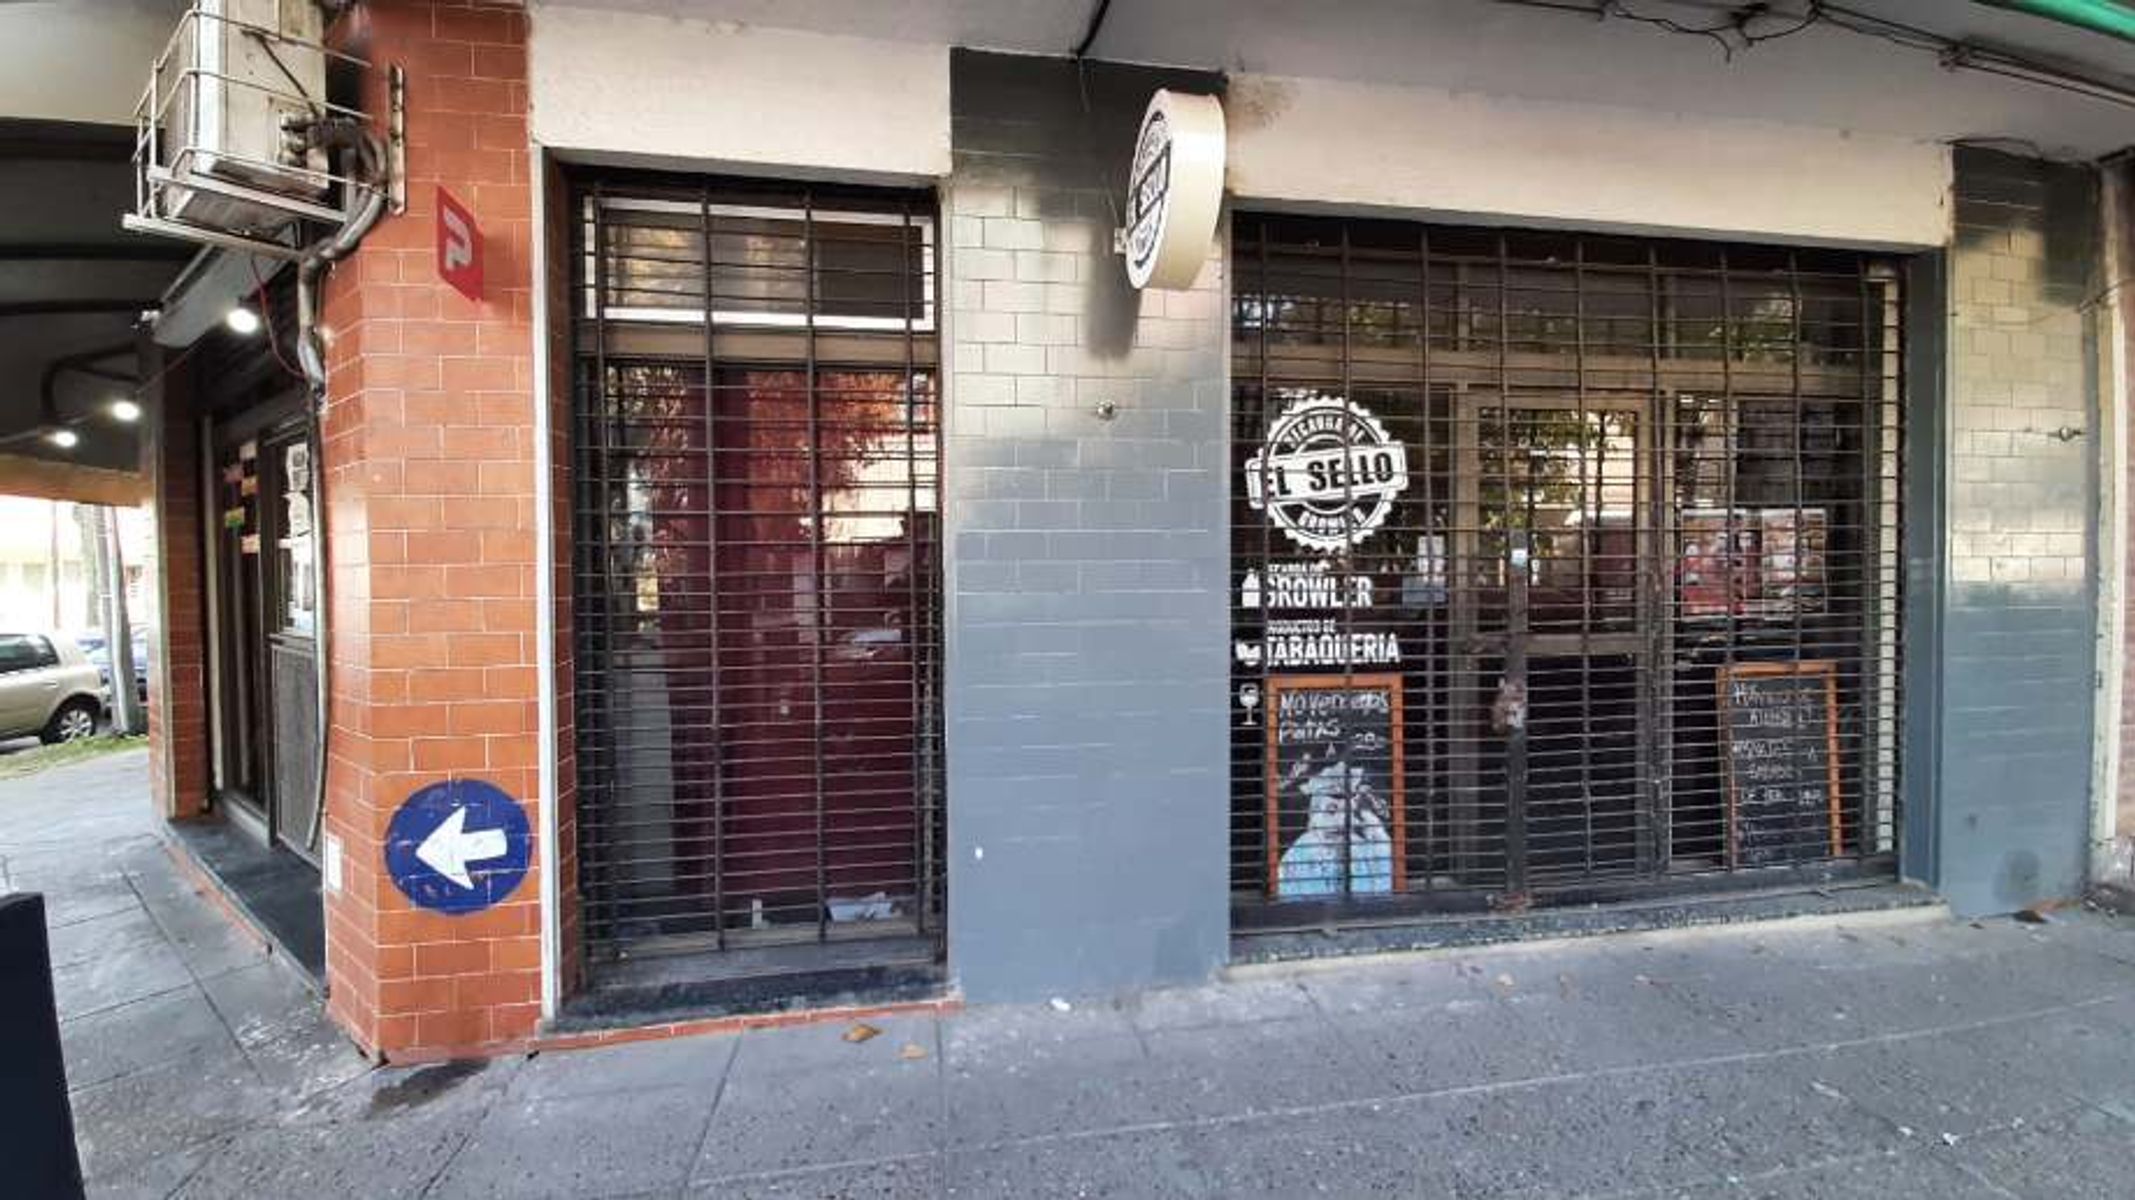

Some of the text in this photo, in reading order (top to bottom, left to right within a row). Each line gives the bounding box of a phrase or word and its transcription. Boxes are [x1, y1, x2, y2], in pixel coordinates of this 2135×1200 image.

[1307, 453, 1393, 491] SELLO
[1266, 576, 1373, 608] GROWLER
[1266, 633, 1400, 666] TABAQUERIA
